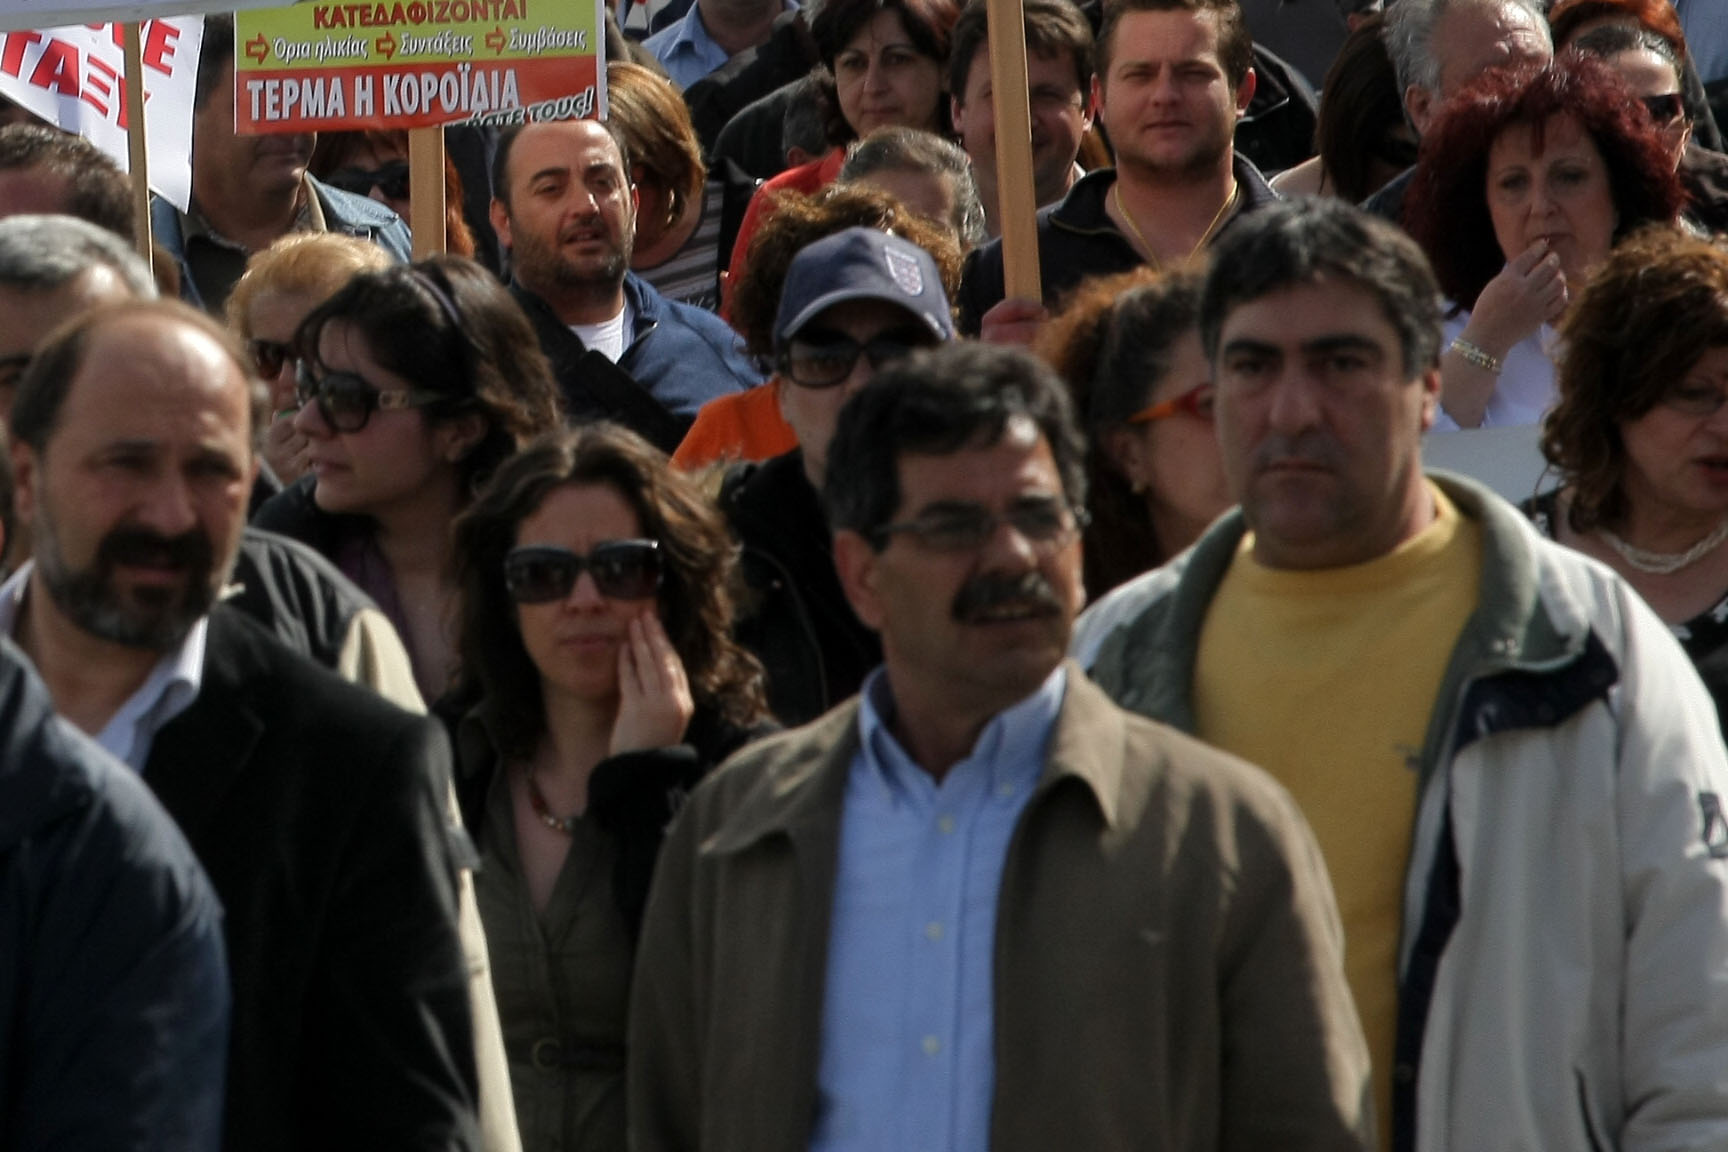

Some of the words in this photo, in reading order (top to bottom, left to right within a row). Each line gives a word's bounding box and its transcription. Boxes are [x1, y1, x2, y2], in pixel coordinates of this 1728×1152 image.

[272, 36, 311, 62] Όρια
[314, 34, 369, 61] ηλικίας
[399, 31, 474, 58] Συντάξεις
[509, 27, 587, 54] Συμβάσεις
[246, 76, 344, 122] ΤΕΡΜΑ
[354, 74, 374, 117] Η
[382, 63, 521, 118] ΚΟΡΟΪΔΙΑ
